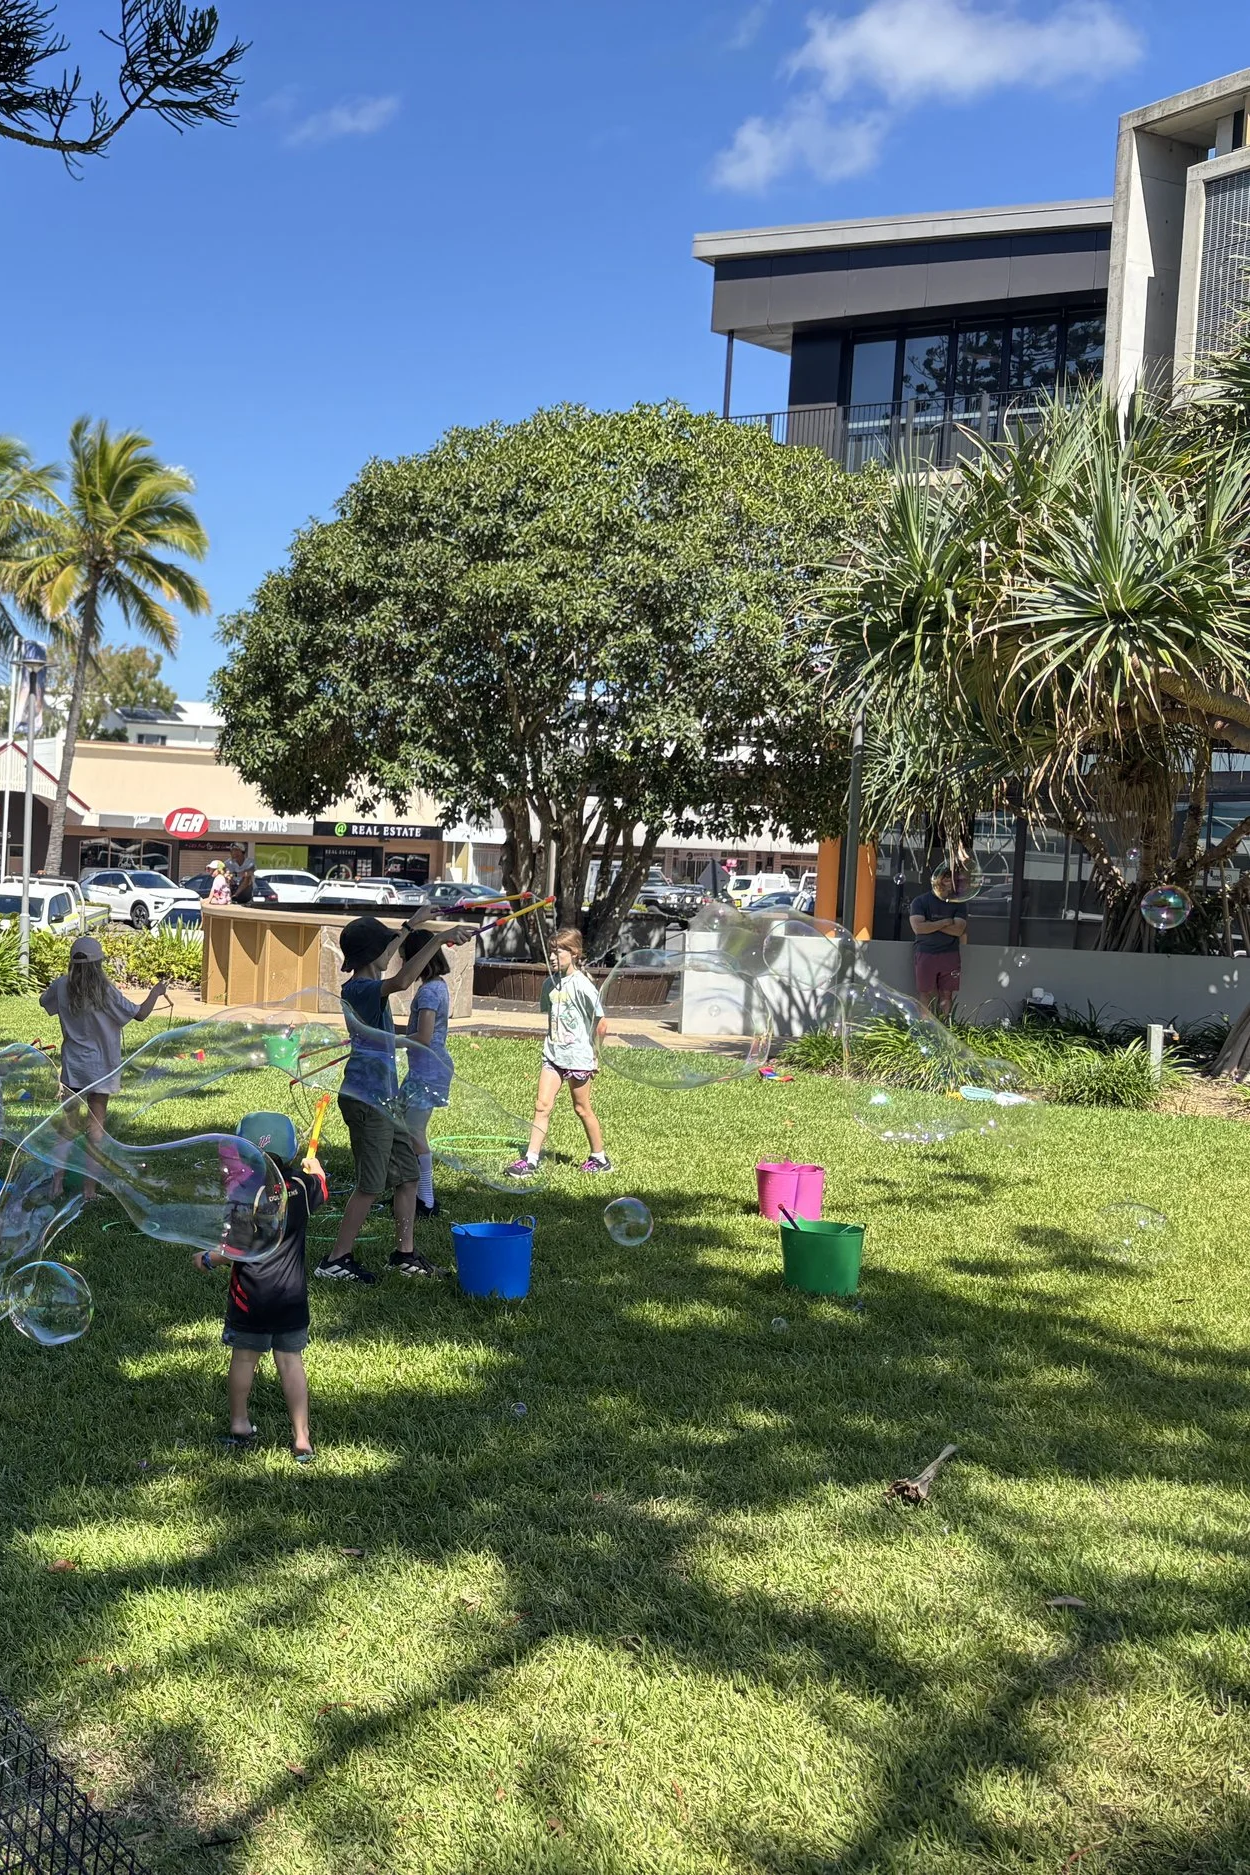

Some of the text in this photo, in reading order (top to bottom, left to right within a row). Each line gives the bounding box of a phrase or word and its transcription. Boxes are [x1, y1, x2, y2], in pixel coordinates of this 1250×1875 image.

[169, 813, 205, 833] IGA
[268, 820, 288, 833] DAYS
[351, 825, 379, 836] REAL
[383, 826, 422, 838] ESTATE
[269, 1189, 299, 1202] DOLINS
